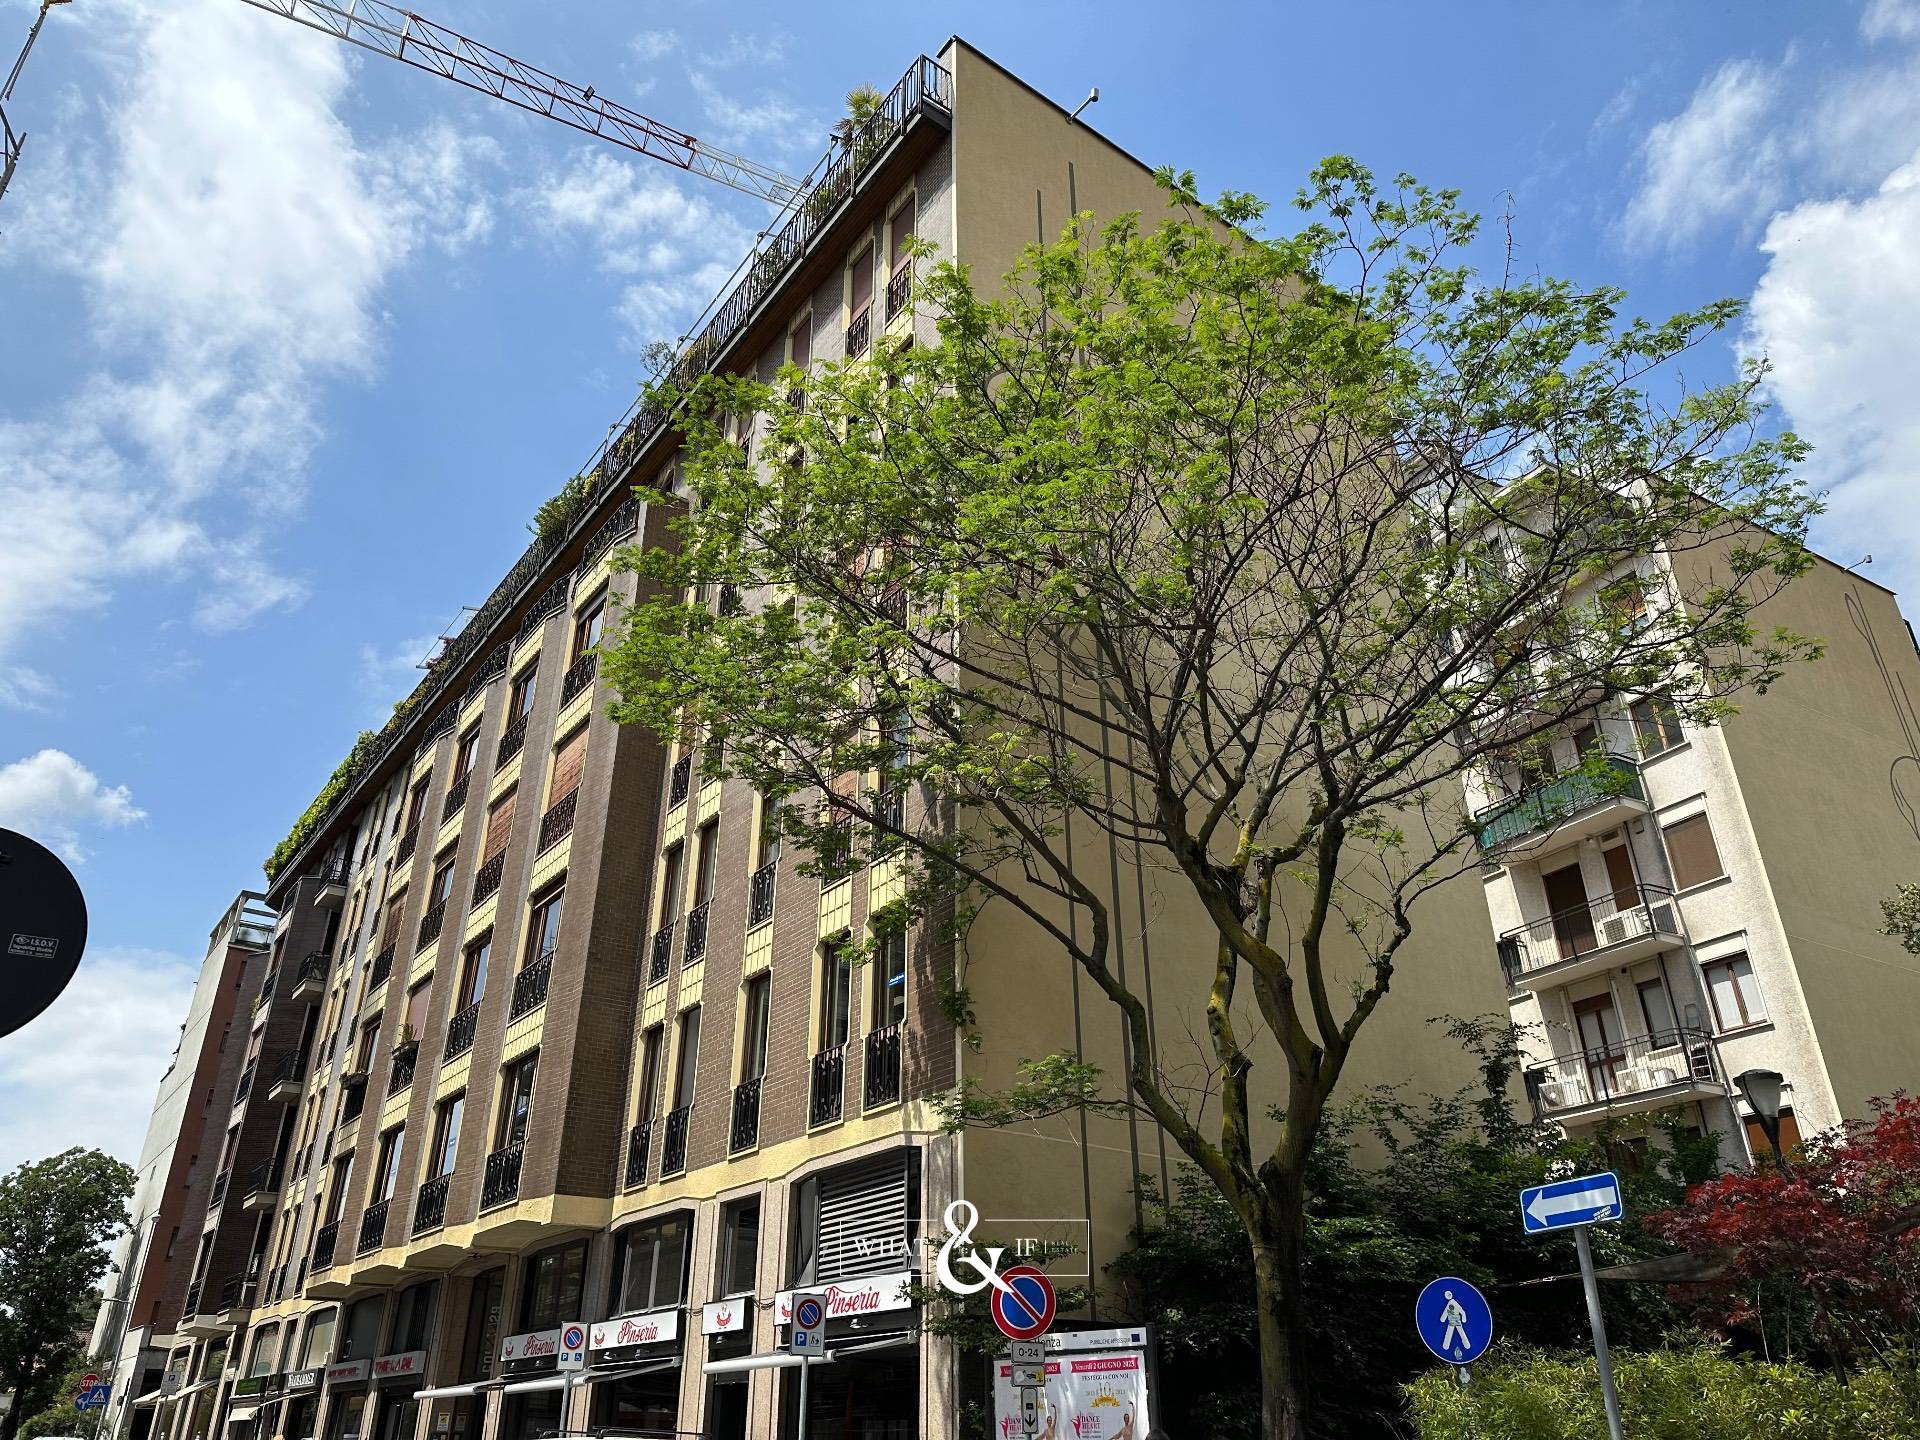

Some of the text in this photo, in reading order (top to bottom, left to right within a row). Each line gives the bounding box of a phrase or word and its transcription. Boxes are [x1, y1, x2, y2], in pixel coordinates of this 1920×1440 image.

[824, 1285, 880, 1314] Pinseria
[617, 1320, 658, 1344] Pinseria
[523, 1335, 555, 1356] Pinseria
[1018, 1347, 1039, 1357] 0-24
[1097, 1361, 1121, 1369] GIUGNO
[81, 1379, 99, 1387] STOP
